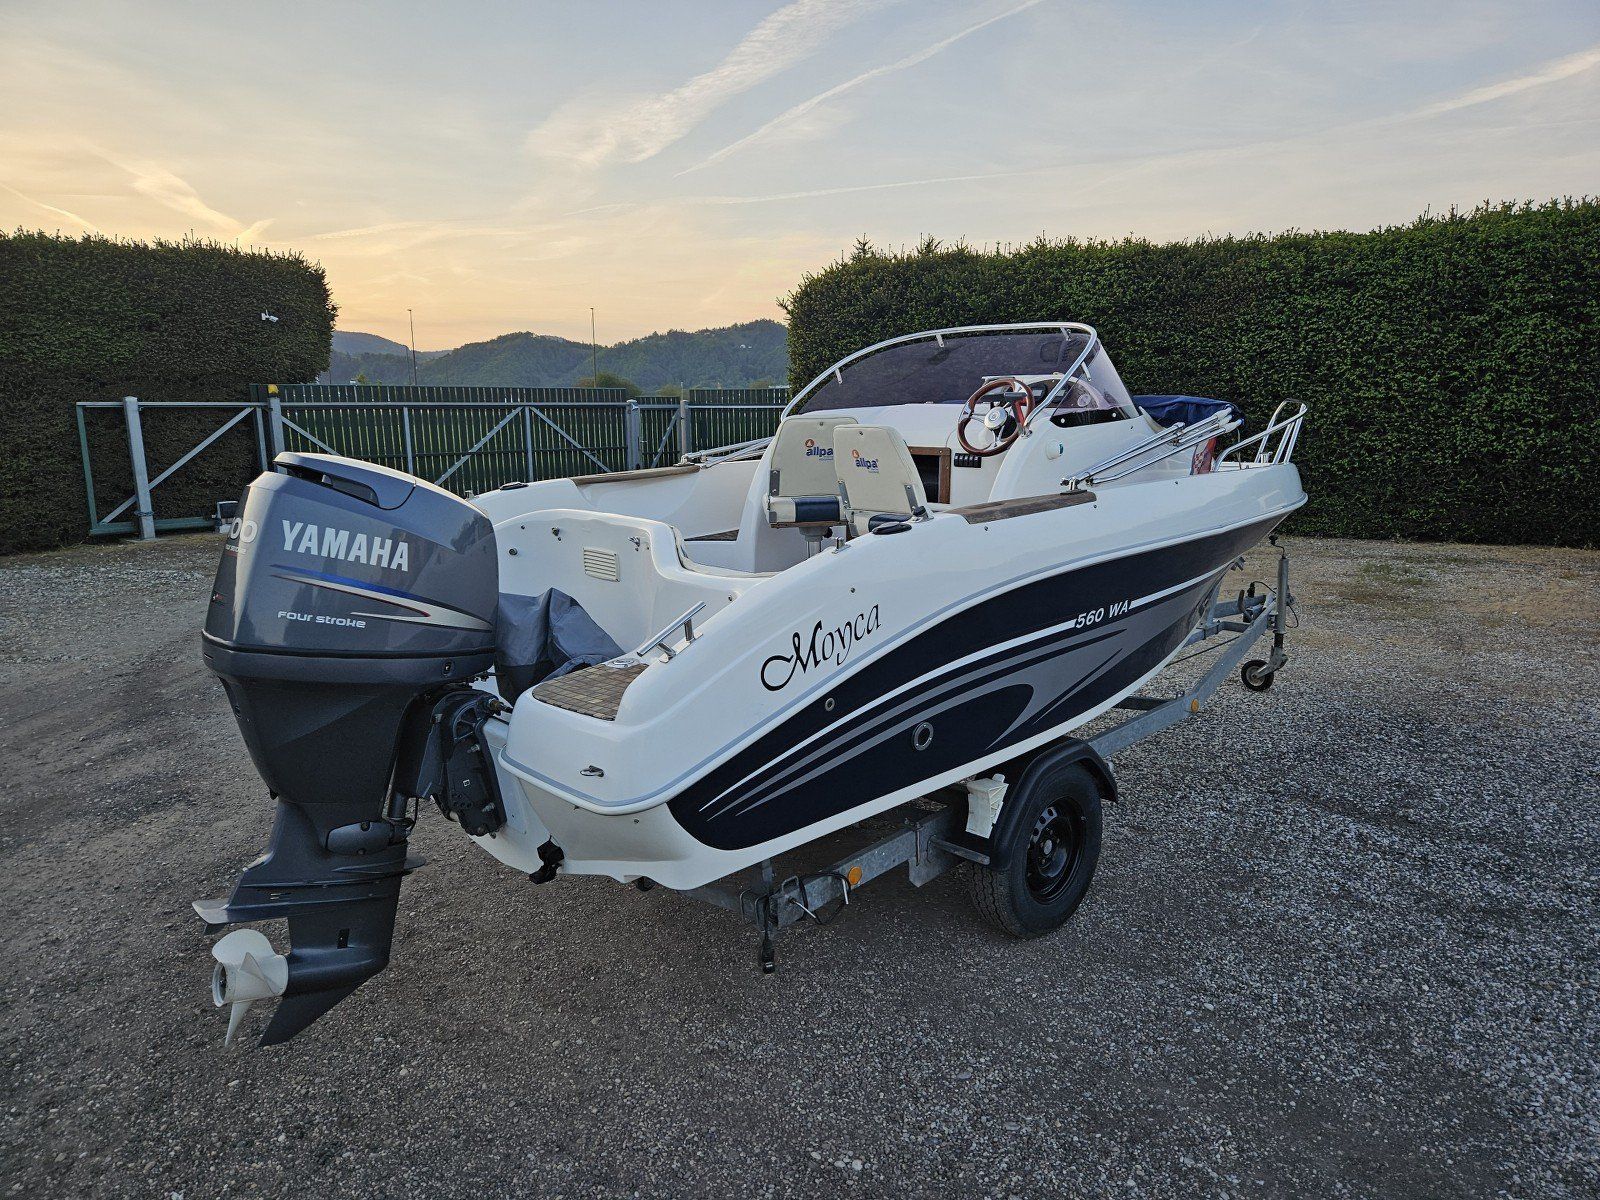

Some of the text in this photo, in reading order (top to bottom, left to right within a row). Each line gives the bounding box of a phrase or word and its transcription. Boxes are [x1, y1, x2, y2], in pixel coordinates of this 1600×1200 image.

[805, 446, 834, 458] allpa
[229, 517, 258, 543] 00
[282, 519, 409, 572] YAMAHA
[1075, 599, 1129, 629] 560 WA
[760, 603, 882, 692] Moyca
